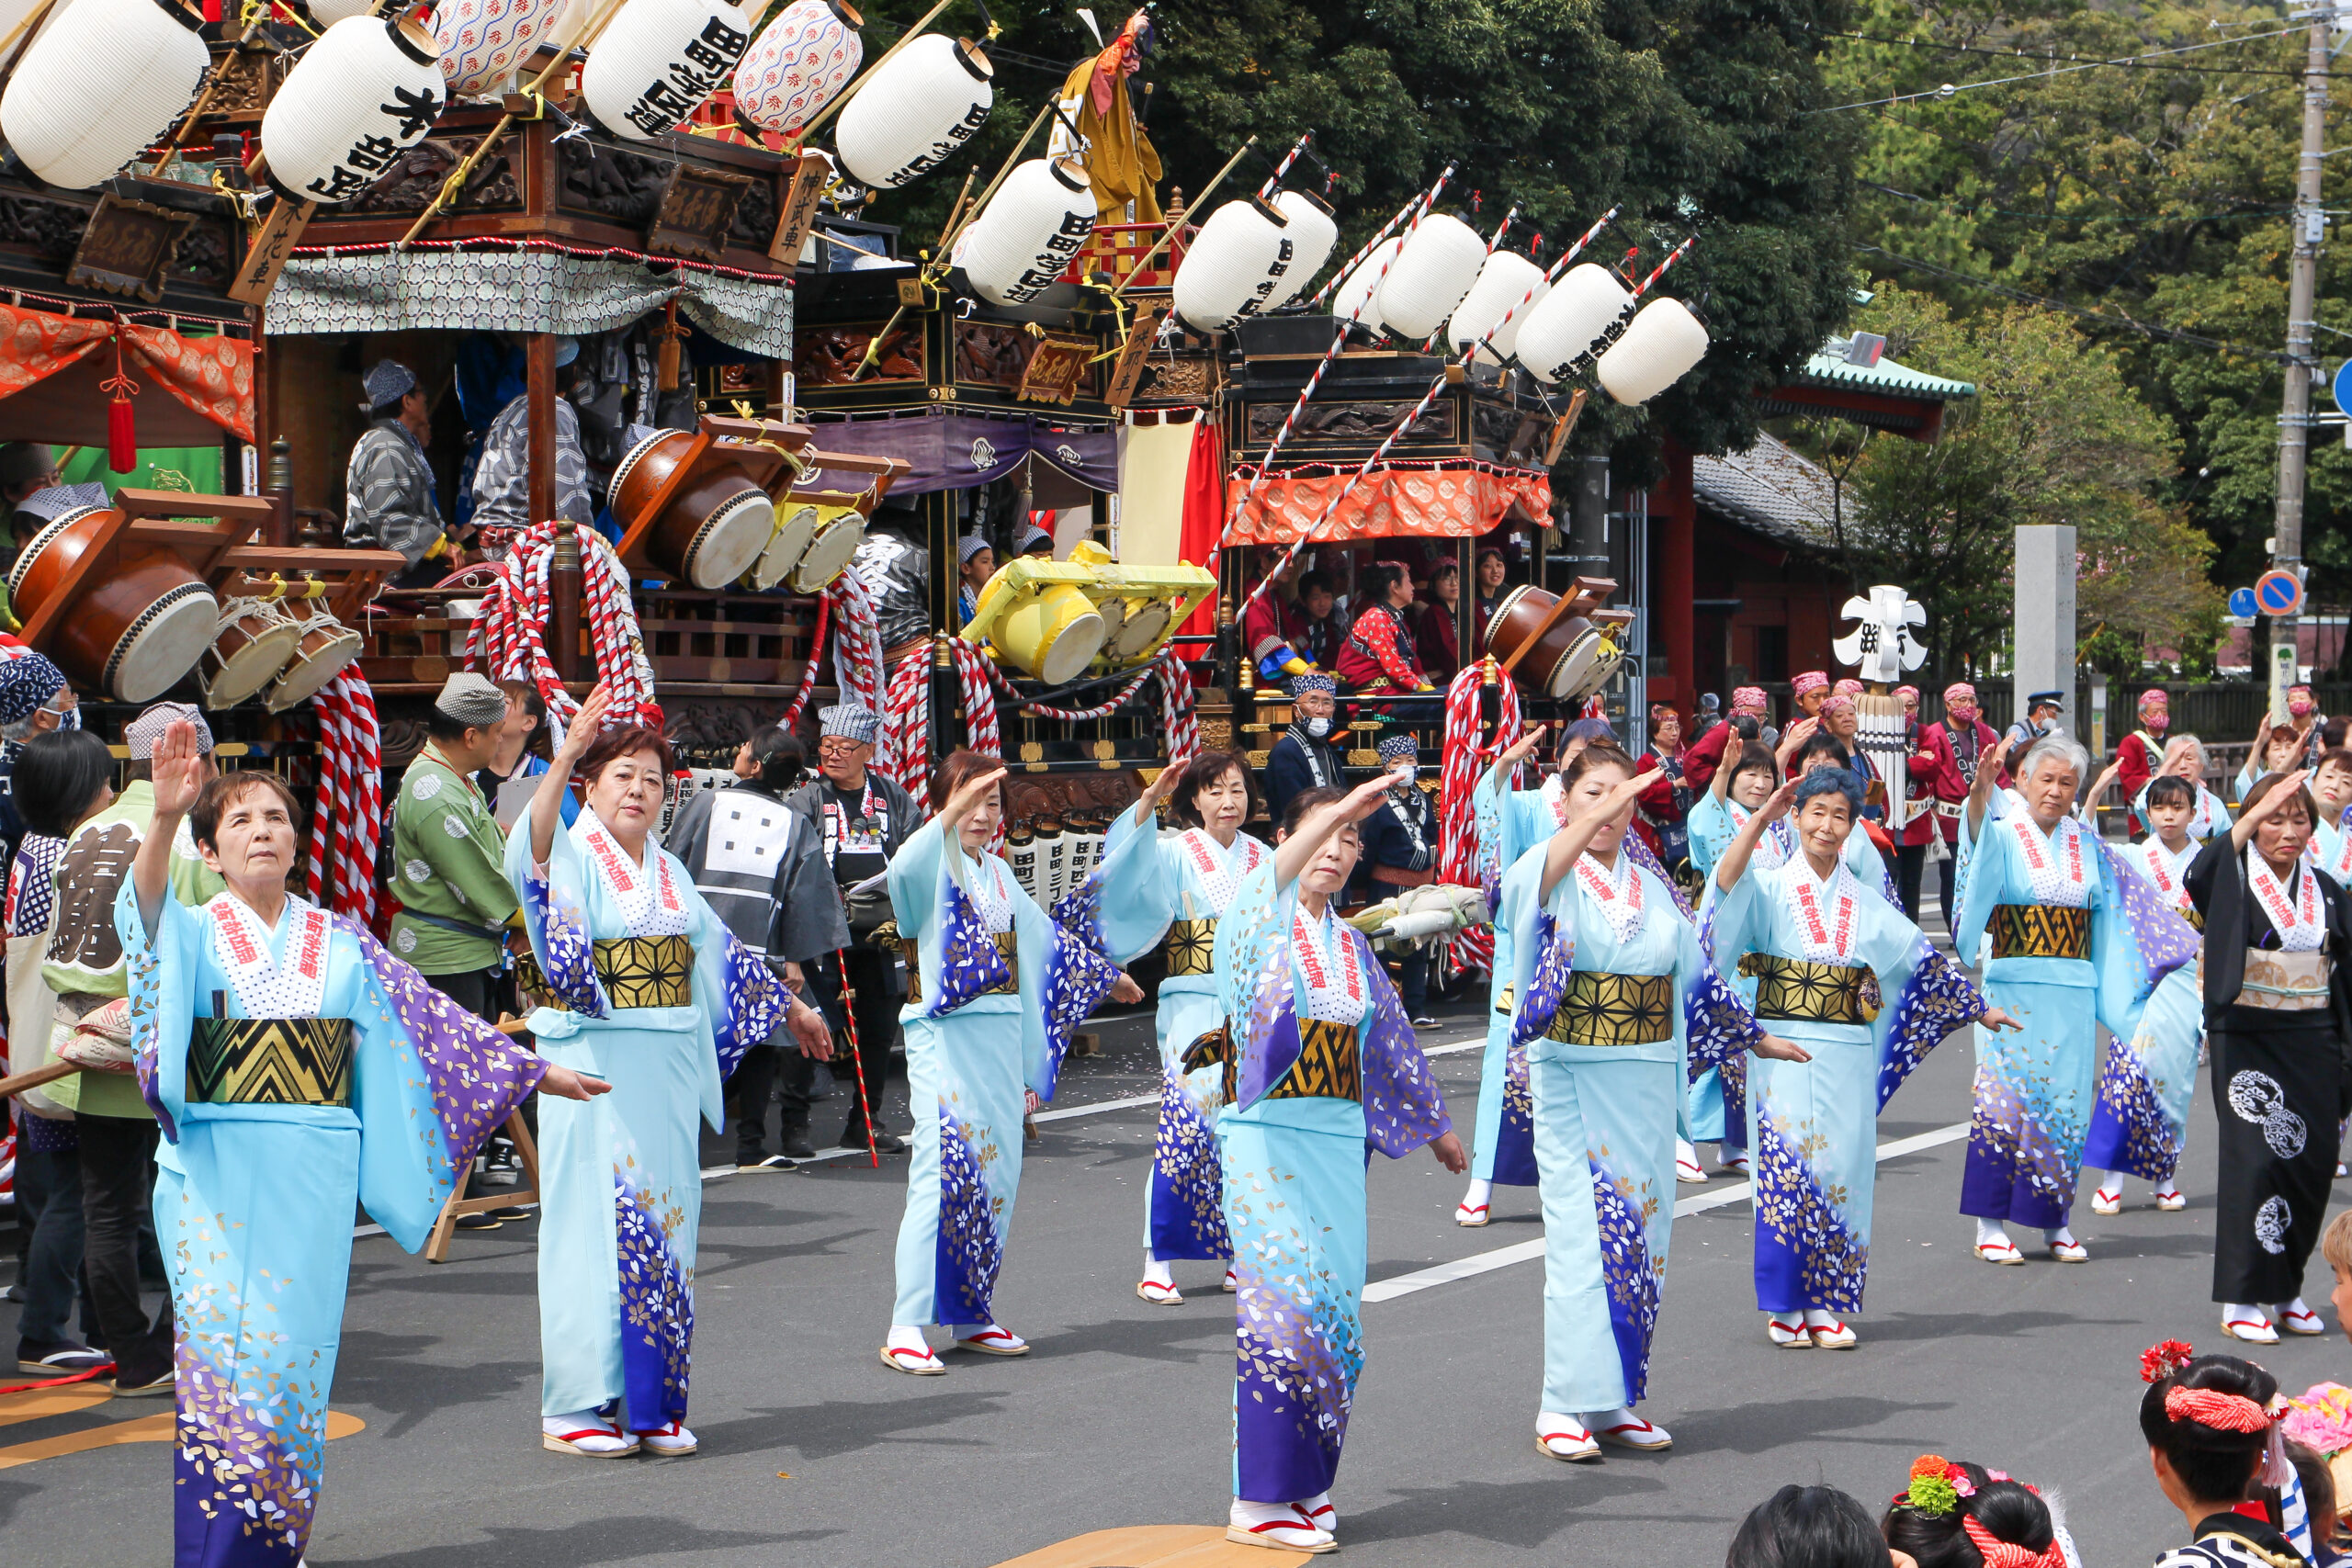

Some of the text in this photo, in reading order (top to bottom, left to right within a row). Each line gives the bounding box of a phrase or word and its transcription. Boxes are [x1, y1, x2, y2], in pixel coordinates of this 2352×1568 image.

[625, 16, 749, 138] 田町学区連
[247, 199, 304, 290] 木花車
[781, 170, 821, 252] 神武車
[1115, 327, 1150, 398] 咲耶車
